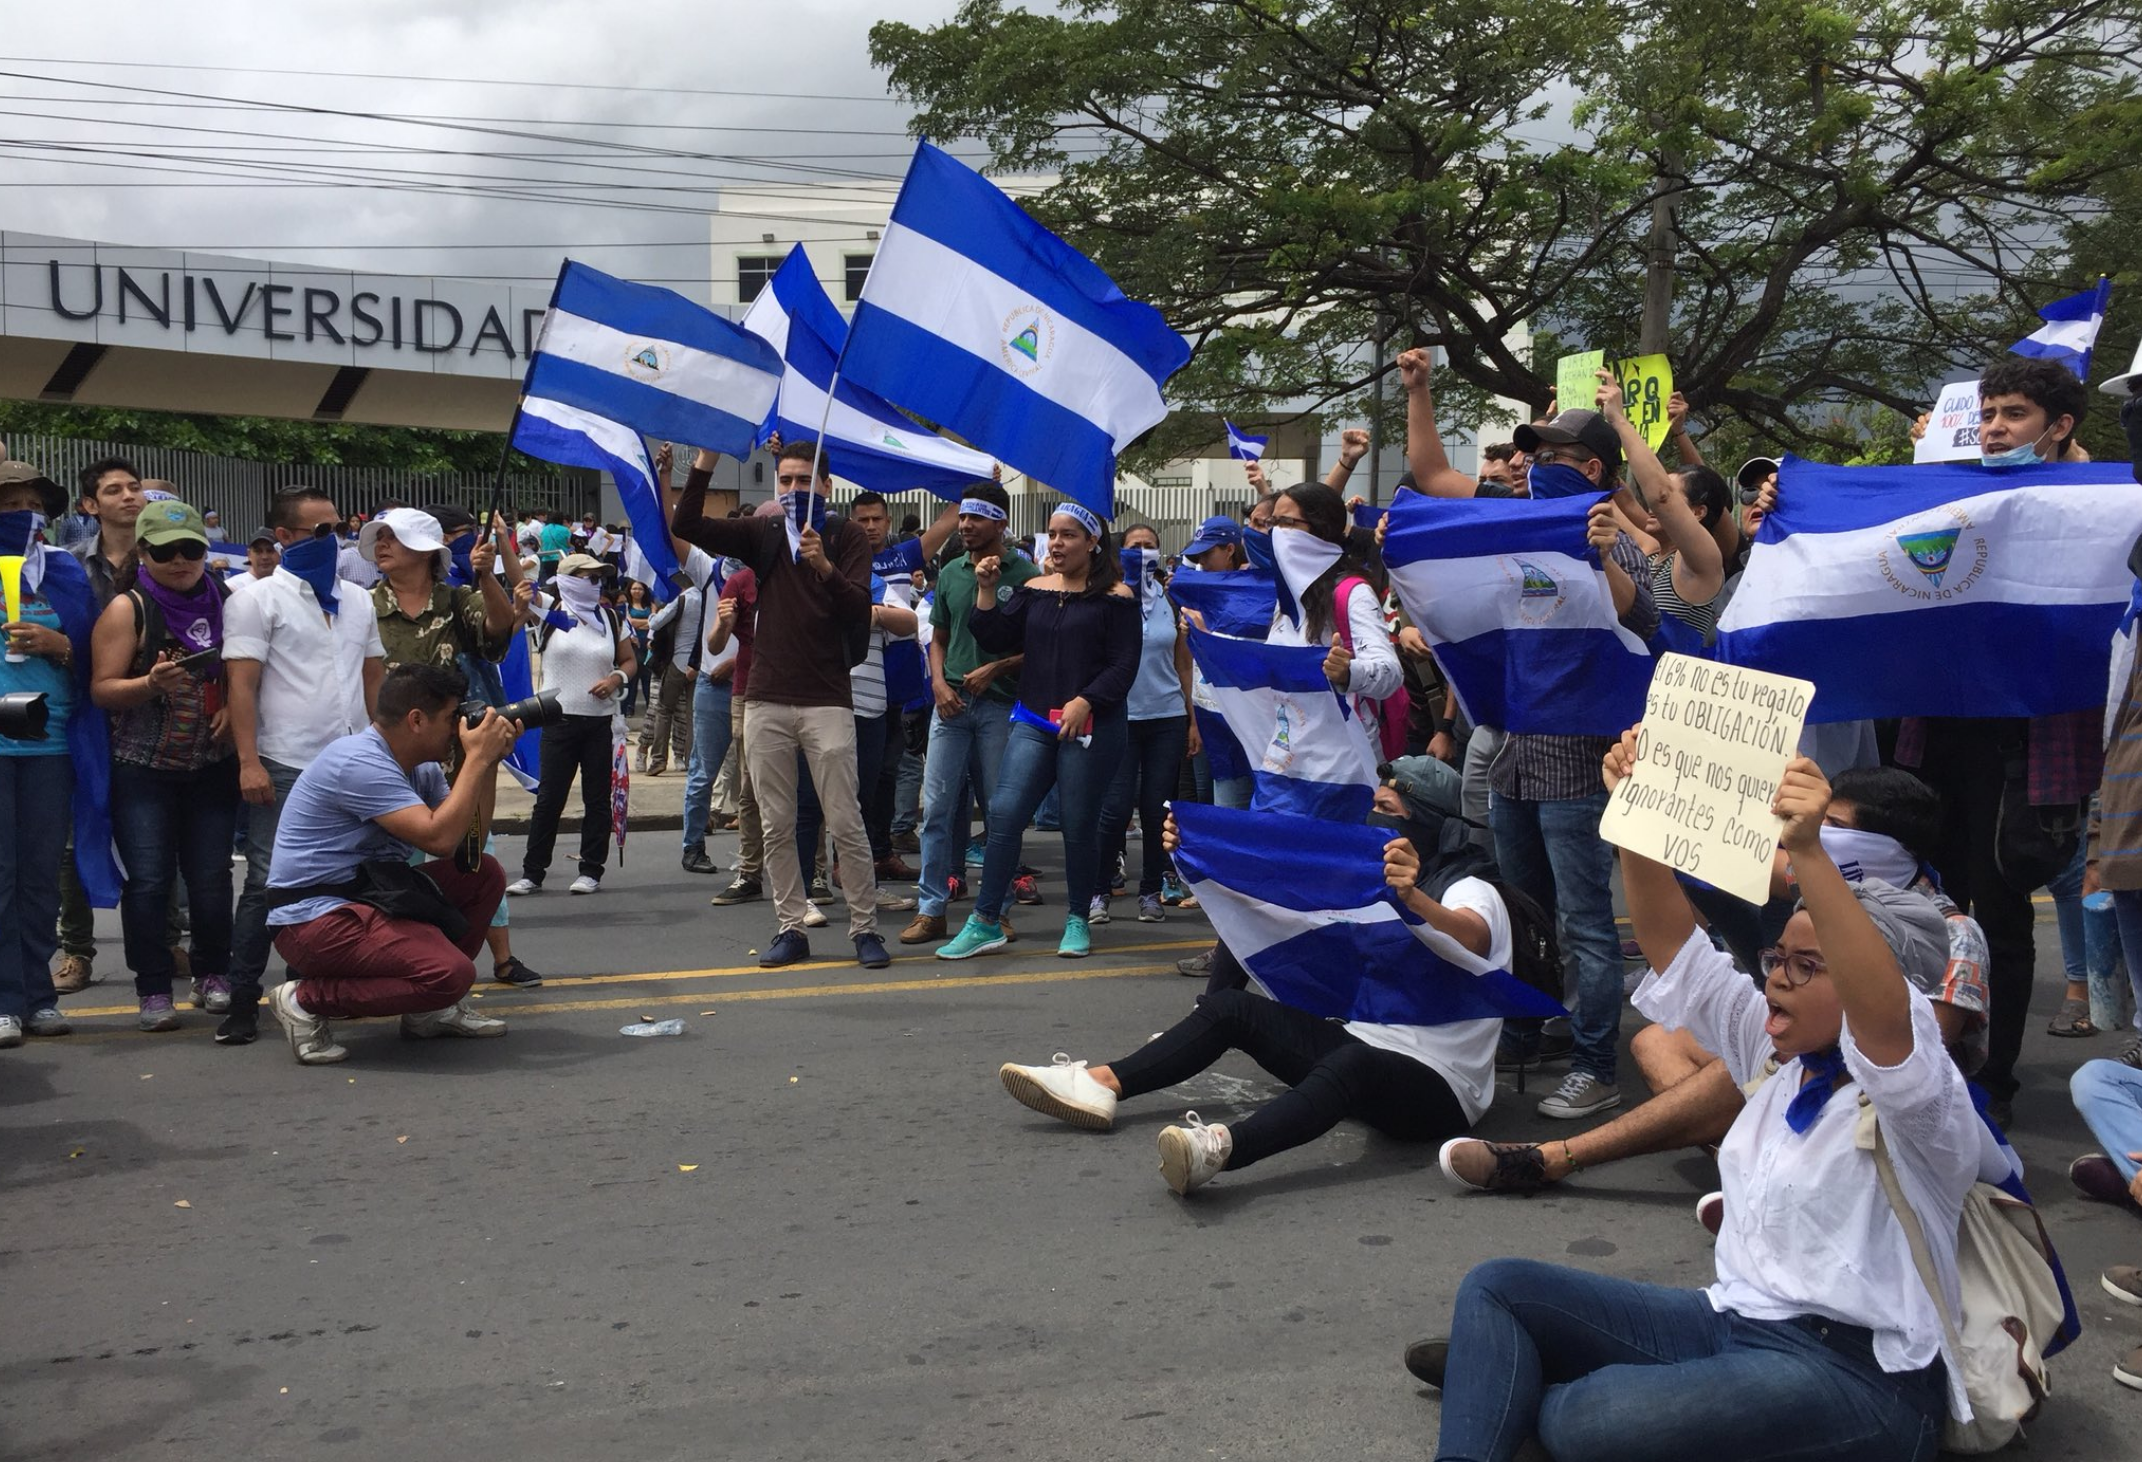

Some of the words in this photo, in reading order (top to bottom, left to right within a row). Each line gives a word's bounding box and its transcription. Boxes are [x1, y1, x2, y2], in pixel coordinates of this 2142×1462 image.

[1002, 305, 1034, 333] REPUBLICA
[1878, 550, 1931, 600] NICARAGUA
[1953, 537, 1988, 593] REPUBLICA
[1935, 589, 1952, 600] DE
[1664, 658, 1687, 686] 6%
[1690, 665, 1710, 692] no
[1711, 674, 1730, 697] es
[1732, 670, 1749, 701] tu
[1662, 693, 1678, 721] tu
[1653, 740, 1671, 768] es
[1675, 750, 1702, 792] que
[1706, 758, 1732, 792] nos
[1737, 773, 1778, 816] quier
